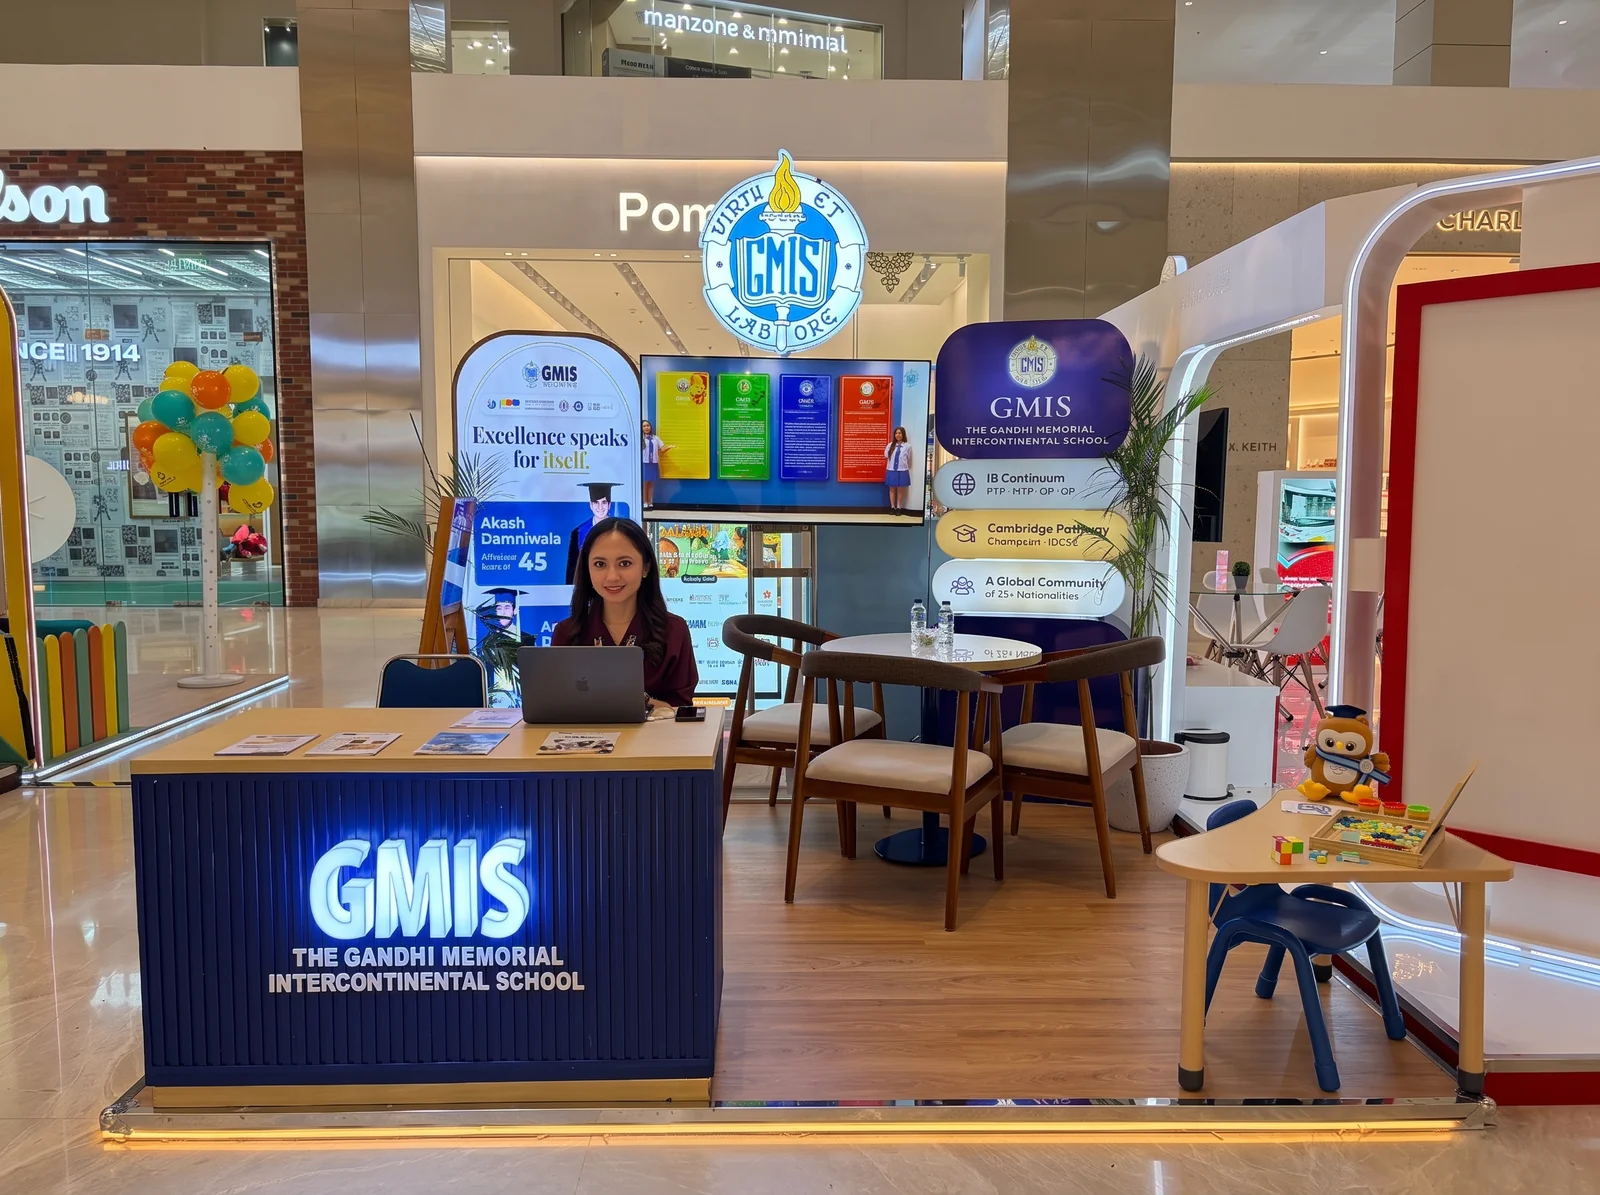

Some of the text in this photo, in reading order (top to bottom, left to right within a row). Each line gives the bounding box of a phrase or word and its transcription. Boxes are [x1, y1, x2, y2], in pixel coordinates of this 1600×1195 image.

[644, 10, 738, 37] manzone
[743, 24, 756, 40] &
[81, 343, 140, 362] 1914
[542, 365, 578, 382] GMIS
[990, 396, 1071, 418] GMIS
[473, 426, 628, 449] Excellence speaks
[966, 425, 1095, 434] THE GANDHI MEMORIAL
[952, 436, 1109, 445] INTERCONTINENTAL SCHOOL
[1242, 442, 1277, 452] KEITH
[514, 450, 590, 469] for itself.
[987, 473, 1065, 483] IB Continuum
[481, 517, 525, 529] Akash
[987, 523, 1109, 537] Cambridge Patay
[481, 532, 561, 545] Damniwala
[518, 551, 548, 571] 45
[985, 576, 1106, 590] A Global Community
[985, 590, 995, 598] of
[1016, 590, 1079, 600] Nationalities
[310, 838, 530, 939] GMIS
[293, 946, 563, 967] THE GANDHI MEMORIAL
[268, 971, 585, 993] INTERCONTINENTAL SCHOOL
